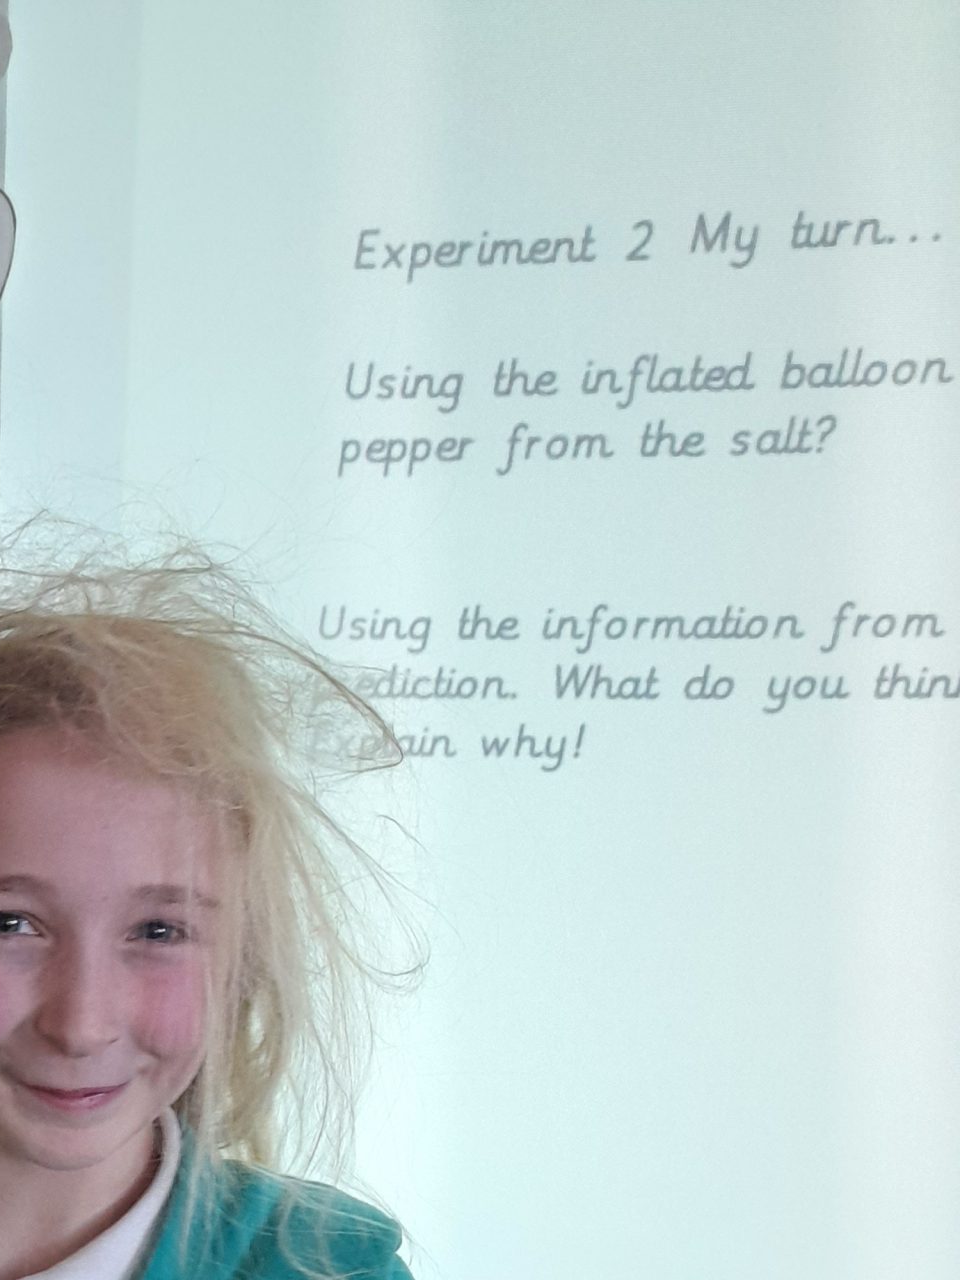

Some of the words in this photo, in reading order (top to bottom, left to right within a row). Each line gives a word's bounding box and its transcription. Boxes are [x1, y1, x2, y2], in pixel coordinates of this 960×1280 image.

[353, 225, 597, 283] Experiment
[625, 220, 655, 262] 2
[691, 211, 761, 269] My
[790, 210, 943, 251] turn...
[344, 362, 463, 414] Using
[493, 358, 559, 398] the
[581, 351, 756, 410] inflated
[780, 347, 955, 391] balloon
[337, 435, 476, 479] pepper
[496, 422, 615, 476] from
[640, 419, 707, 459] the
[730, 414, 839, 457] salt?
[317, 604, 432, 655] Using
[458, 603, 521, 642] the
[542, 603, 806, 655] information
[820, 600, 946, 653] from
[554, 663, 661, 701] What
[683, 663, 736, 701] do
[763, 672, 850, 715] you
[873, 663, 960, 700] thin
[479, 723, 587, 773] why!
